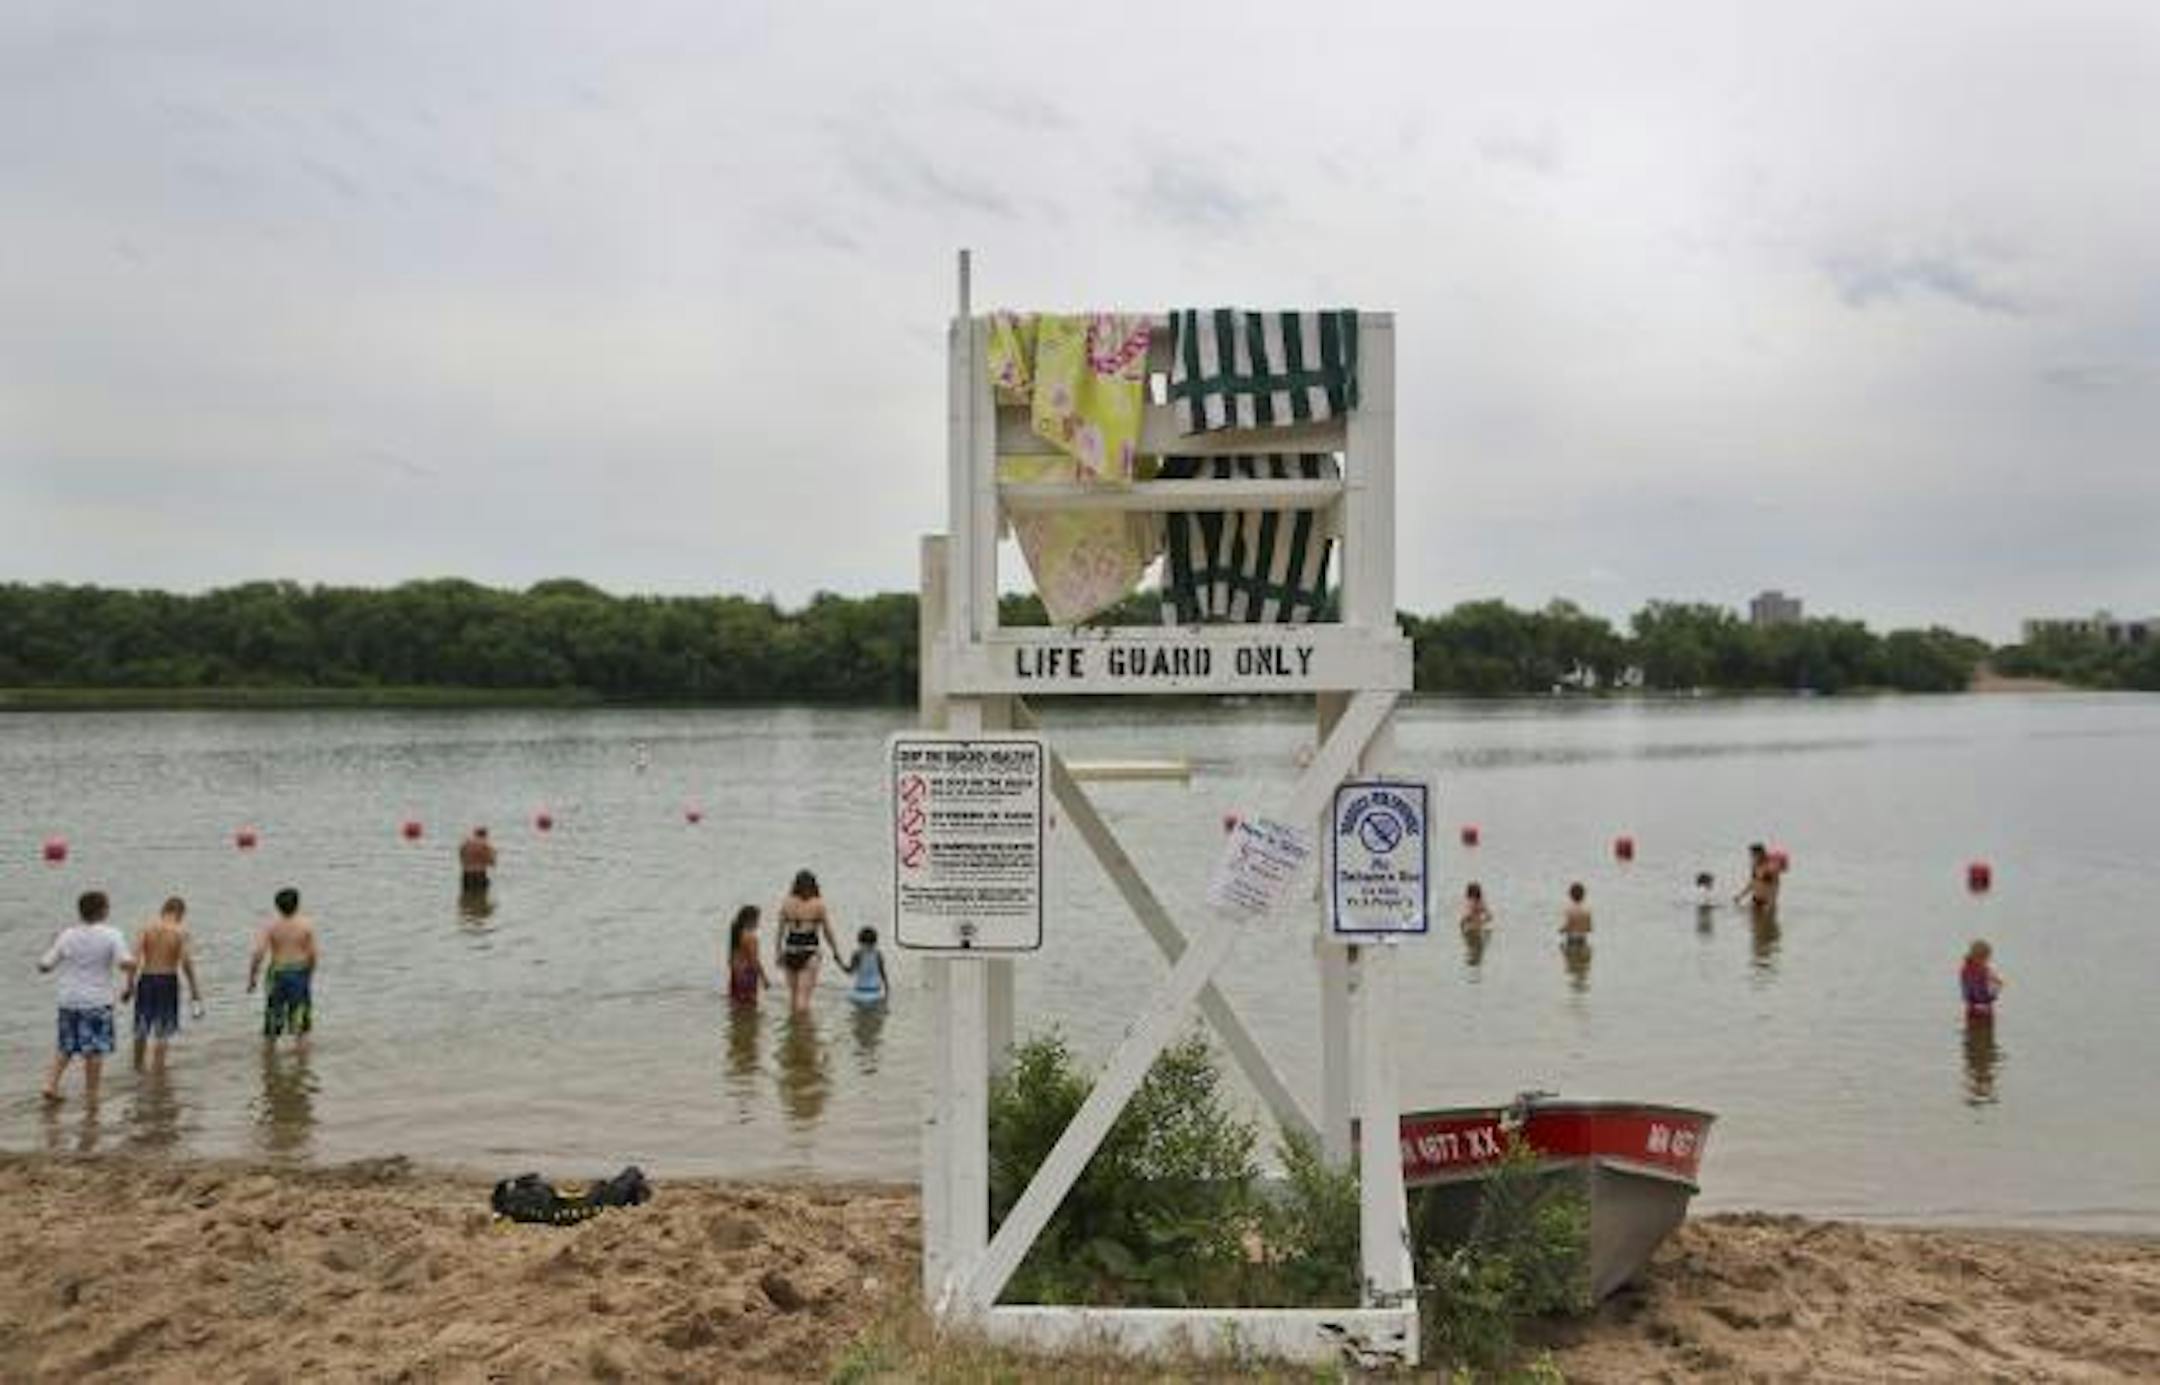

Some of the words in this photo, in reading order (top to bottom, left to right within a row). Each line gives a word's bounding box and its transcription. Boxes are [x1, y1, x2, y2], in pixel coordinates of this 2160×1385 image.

[1015, 647, 1085, 679] LIFE
[1108, 646, 1212, 678] GUARD
[1236, 645, 1315, 677] ONLY
